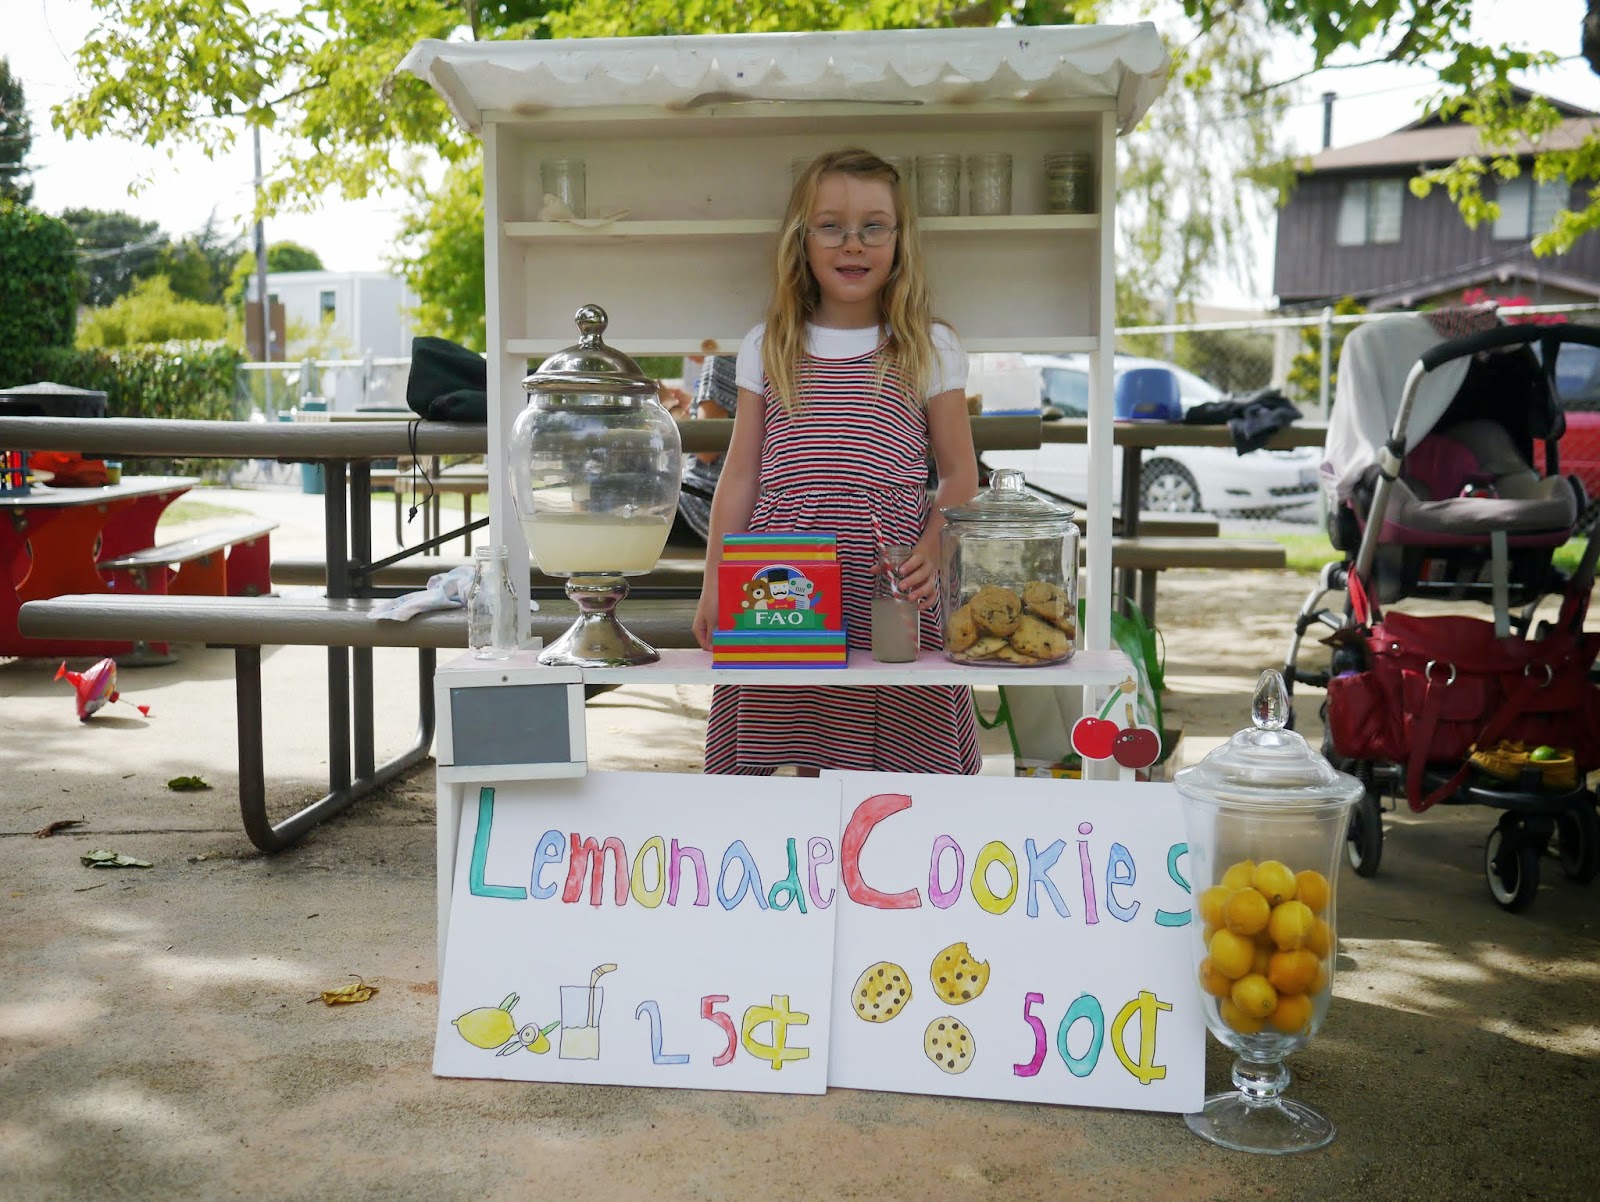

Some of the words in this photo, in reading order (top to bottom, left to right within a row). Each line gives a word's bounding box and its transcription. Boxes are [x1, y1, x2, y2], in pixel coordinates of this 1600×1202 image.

[469, 787, 836, 914] Lemonade
[635, 994, 810, 1070] 25¢
[1012, 990, 1174, 1085] 50¢
